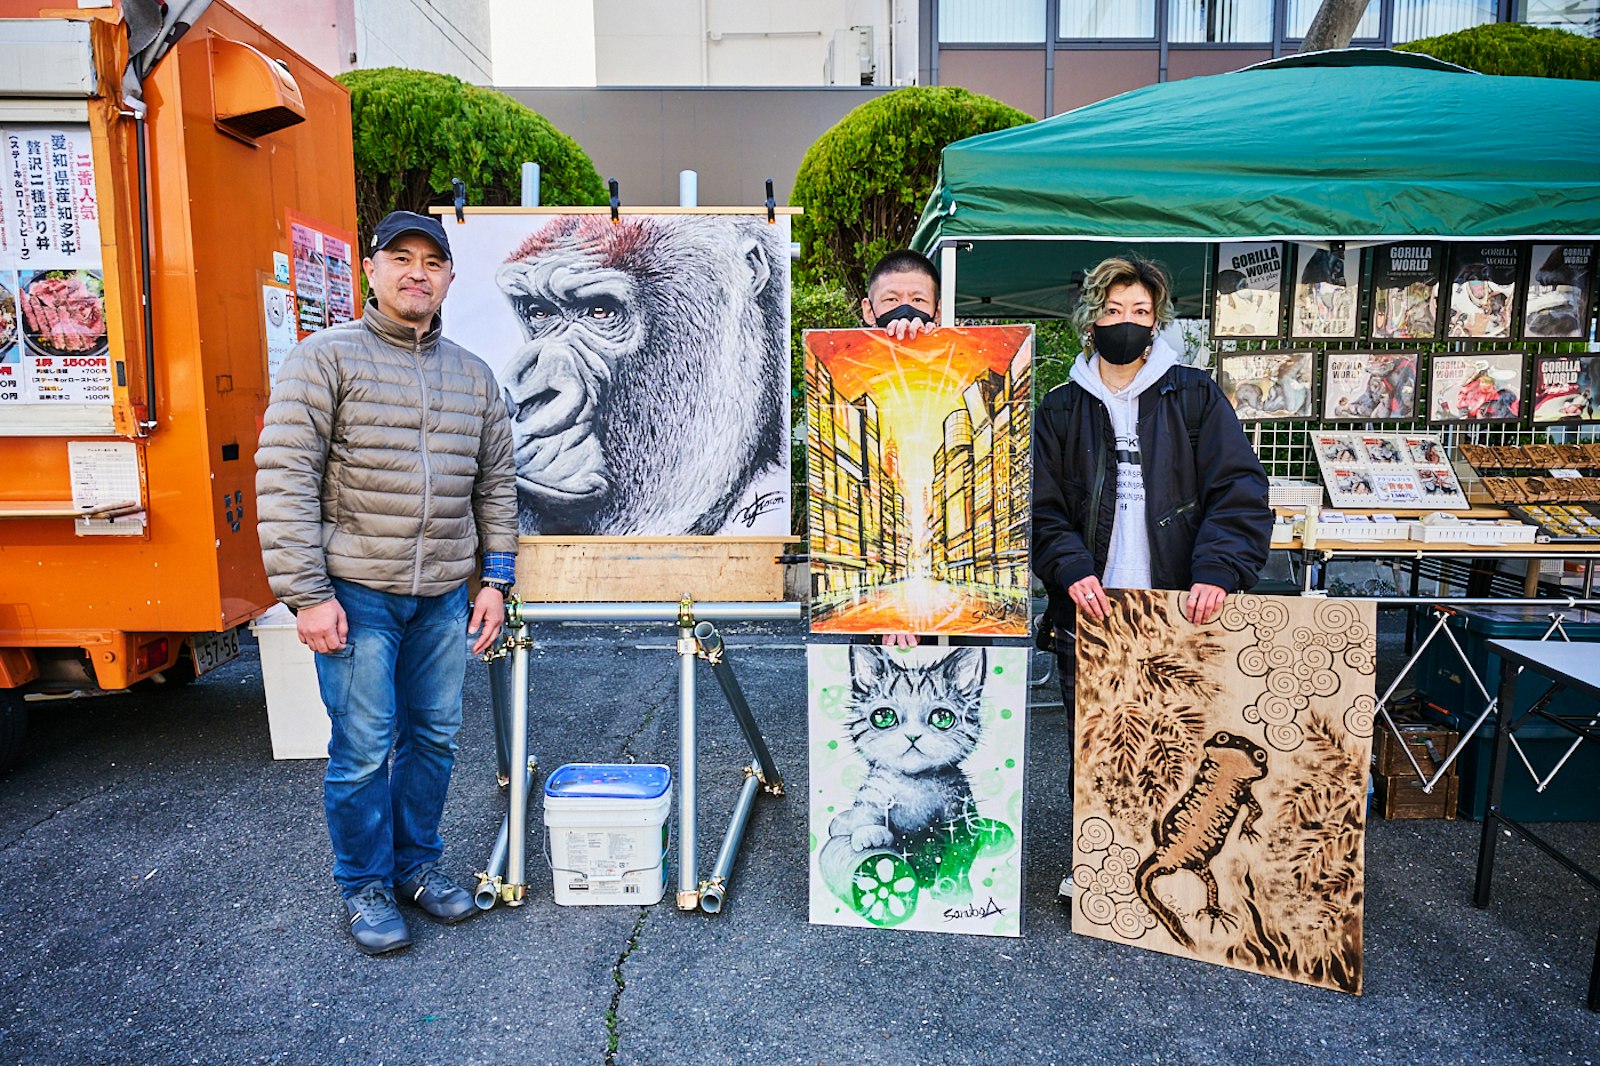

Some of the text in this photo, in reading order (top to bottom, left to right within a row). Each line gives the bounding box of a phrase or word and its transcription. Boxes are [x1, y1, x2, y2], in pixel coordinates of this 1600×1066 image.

[77, 154, 95, 221] 二番人気
[27, 140, 50, 250] 贅沢二種盛り丼
[51, 134, 76, 256] 愛知県産知多牛
[74, 214, 82, 250] Prefecture
[1232, 246, 1280, 269] GORILLA
[1390, 246, 1432, 258] GORILLA
[1481, 248, 1518, 256] GORILLA
[1563, 248, 1590, 256] GORILLA
[1392, 259, 1428, 271] WORLD
[1486, 257, 1517, 265] WORLD
[1246, 260, 1280, 278] WORLD
[1266, 272, 1279, 281] play
[62, 358, 106, 366] 1500円
[1332, 362, 1362, 370] GORILLA
[1435, 361, 1465, 370] GORILLA
[1542, 360, 1581, 372] GORILLA
[1334, 370, 1360, 378] WORLD
[1436, 370, 1464, 378] WORLD
[1543, 372, 1578, 385] WORLD
[205, 633, 238, 666] 57-56
